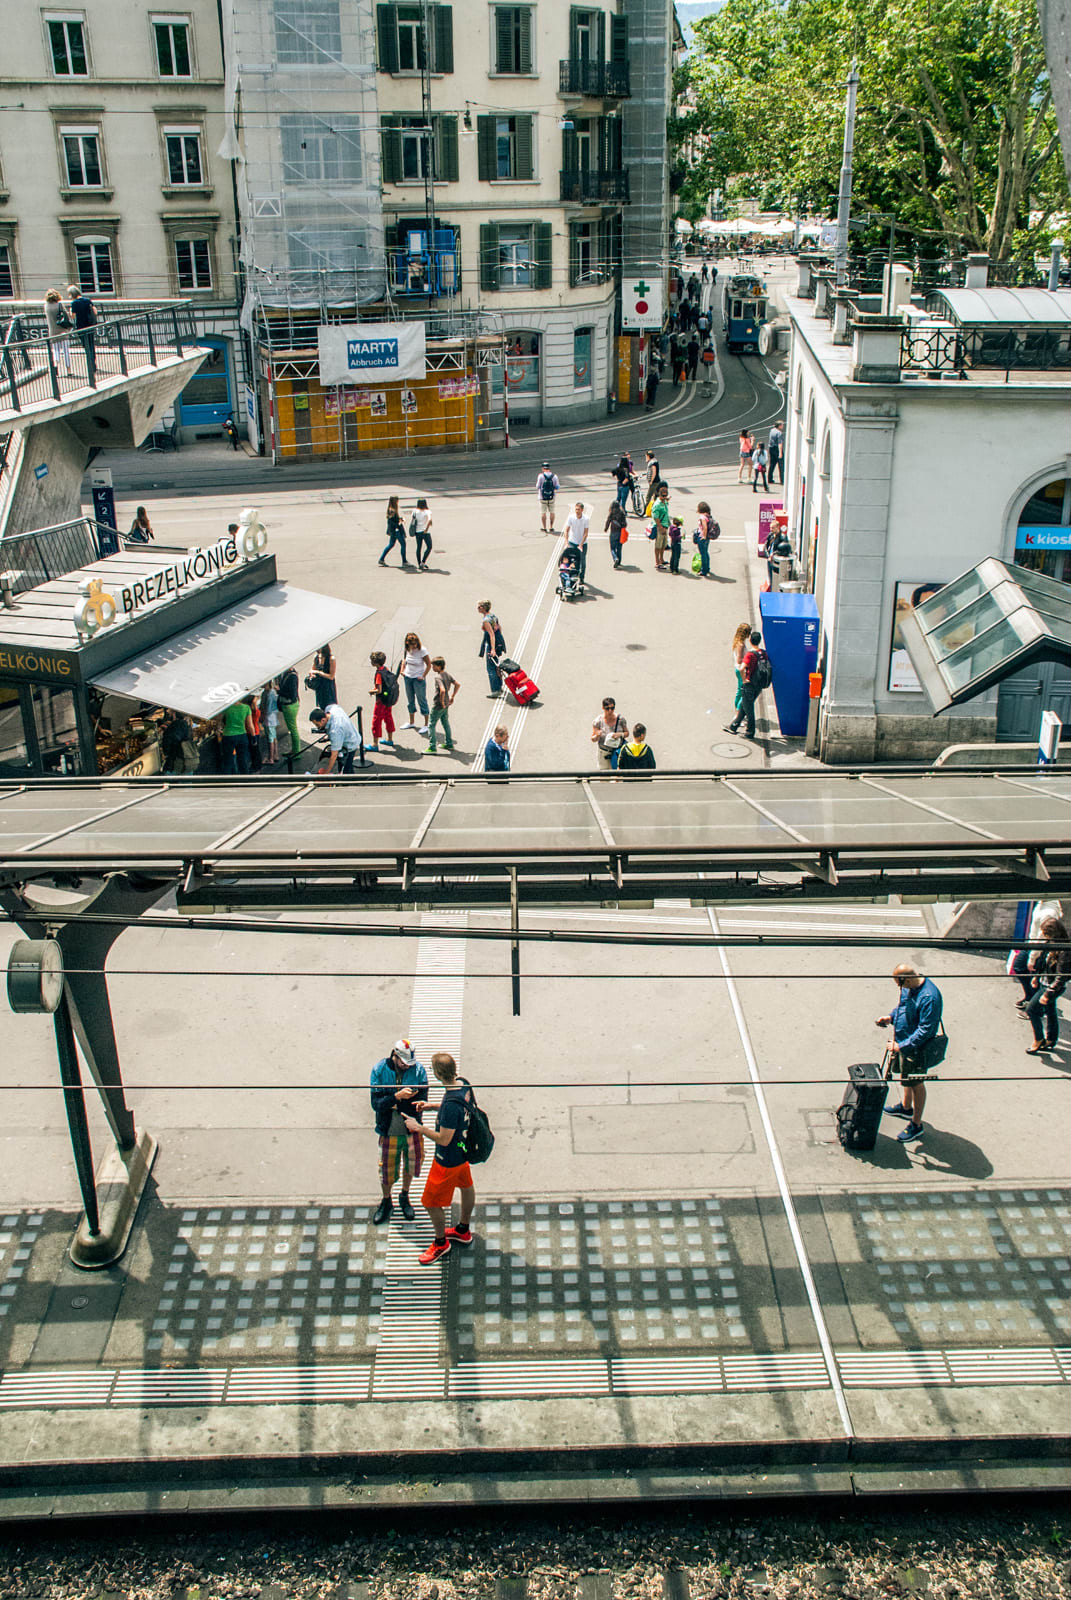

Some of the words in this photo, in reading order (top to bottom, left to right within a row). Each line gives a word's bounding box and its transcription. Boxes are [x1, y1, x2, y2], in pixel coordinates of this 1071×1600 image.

[349, 341, 396, 355] MARTY
[350, 358, 383, 367] Abbruch
[384, 357, 397, 365] AG
[101, 507, 108, 515] 2
[760, 511, 776, 520] Blic
[1025, 533, 1036, 545] k
[121, 540, 238, 614] BREZELKÖNIG
[0, 651, 71, 675] ELKÖNIG
